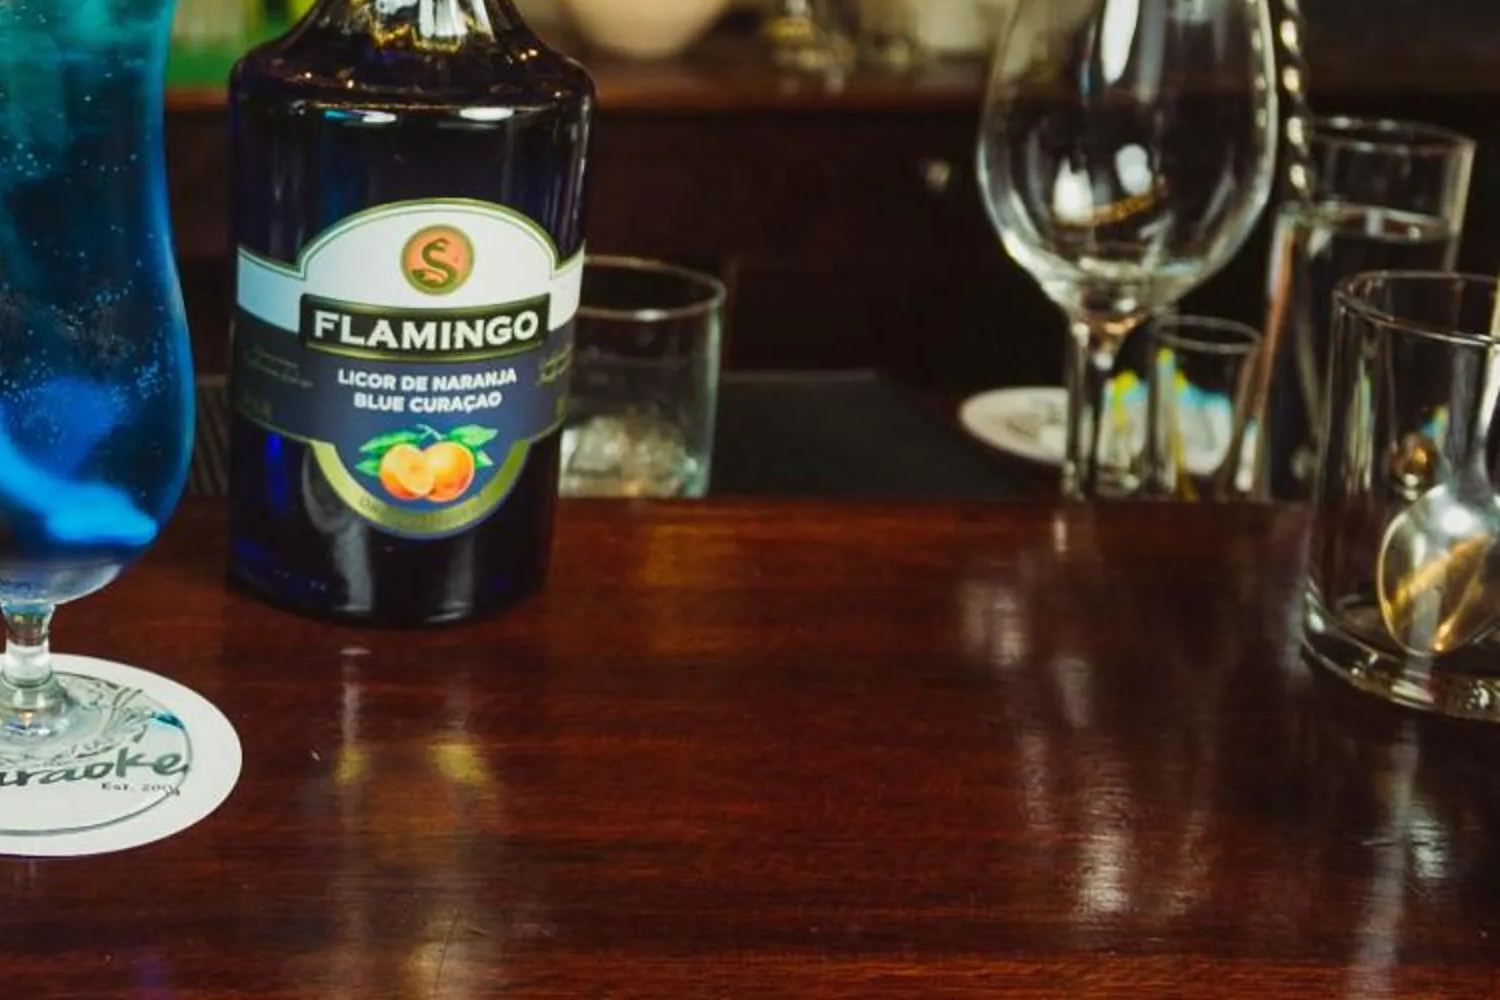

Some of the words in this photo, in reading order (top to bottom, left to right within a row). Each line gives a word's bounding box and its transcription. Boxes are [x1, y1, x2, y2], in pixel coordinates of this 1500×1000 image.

[313, 310, 539, 350] FLAMINGO
[338, 368, 396, 391] LICOR
[402, 375, 429, 392] DE
[433, 367, 517, 392] NARANJA
[354, 391, 404, 412] BLUE
[409, 391, 502, 414] CURAÇAO
